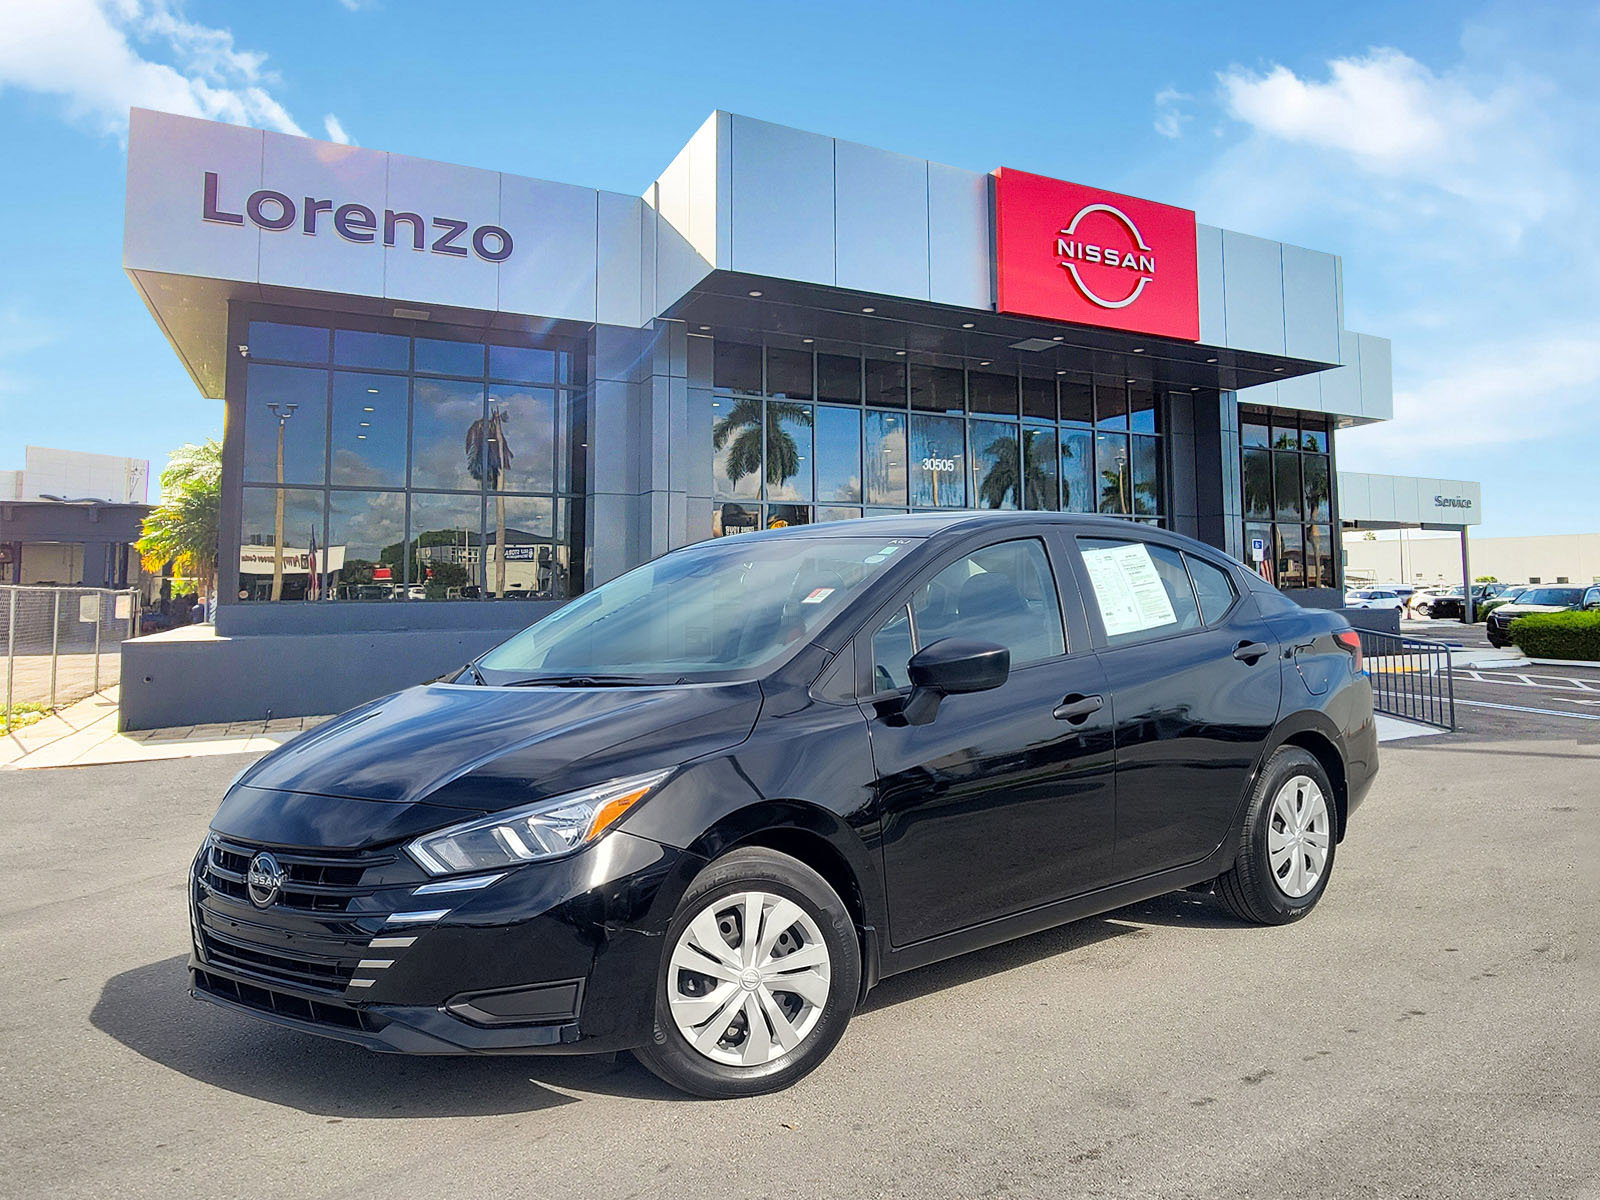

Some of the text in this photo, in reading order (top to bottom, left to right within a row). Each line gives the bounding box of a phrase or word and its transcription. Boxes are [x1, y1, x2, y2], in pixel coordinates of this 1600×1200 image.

[202, 171, 514, 262] Lorenzo
[1057, 238, 1156, 273] NISSAN
[922, 458, 955, 471] 30505
[1434, 495, 1472, 508] Service
